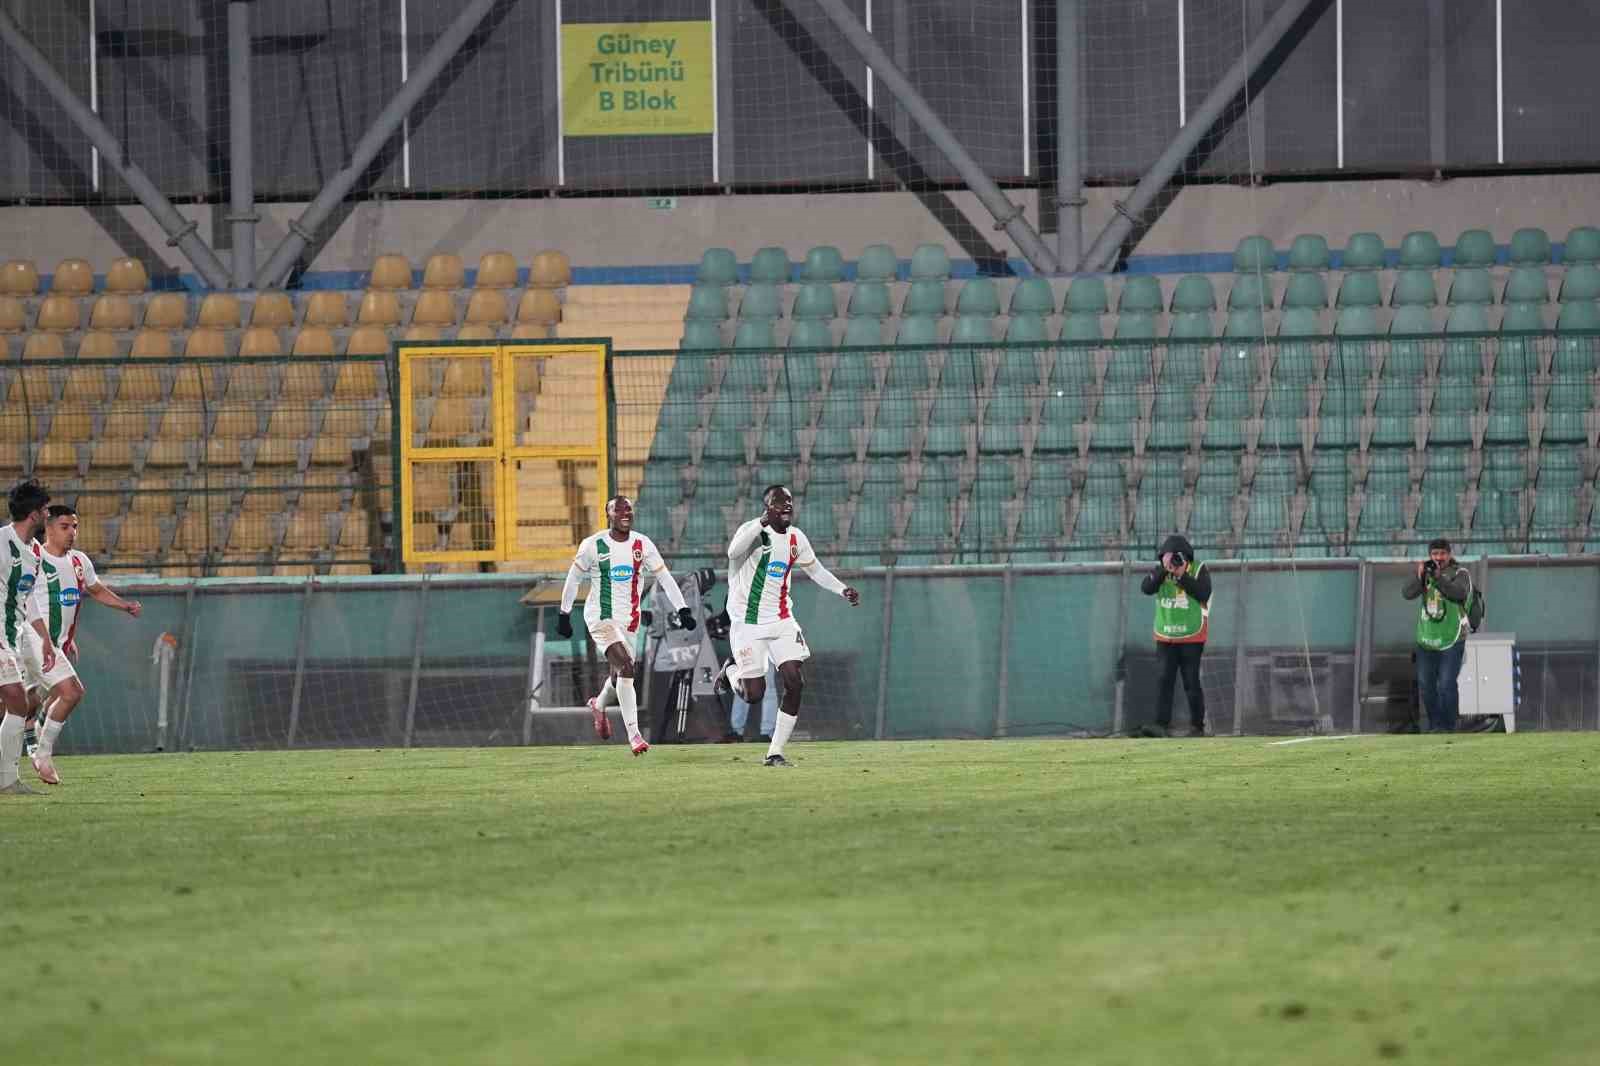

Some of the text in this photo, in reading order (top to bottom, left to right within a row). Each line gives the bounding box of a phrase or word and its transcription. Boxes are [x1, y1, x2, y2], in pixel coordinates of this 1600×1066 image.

[597, 33, 677, 58] Güney
[589, 60, 684, 83] Tribünü
[599, 89, 678, 111] B Blok
